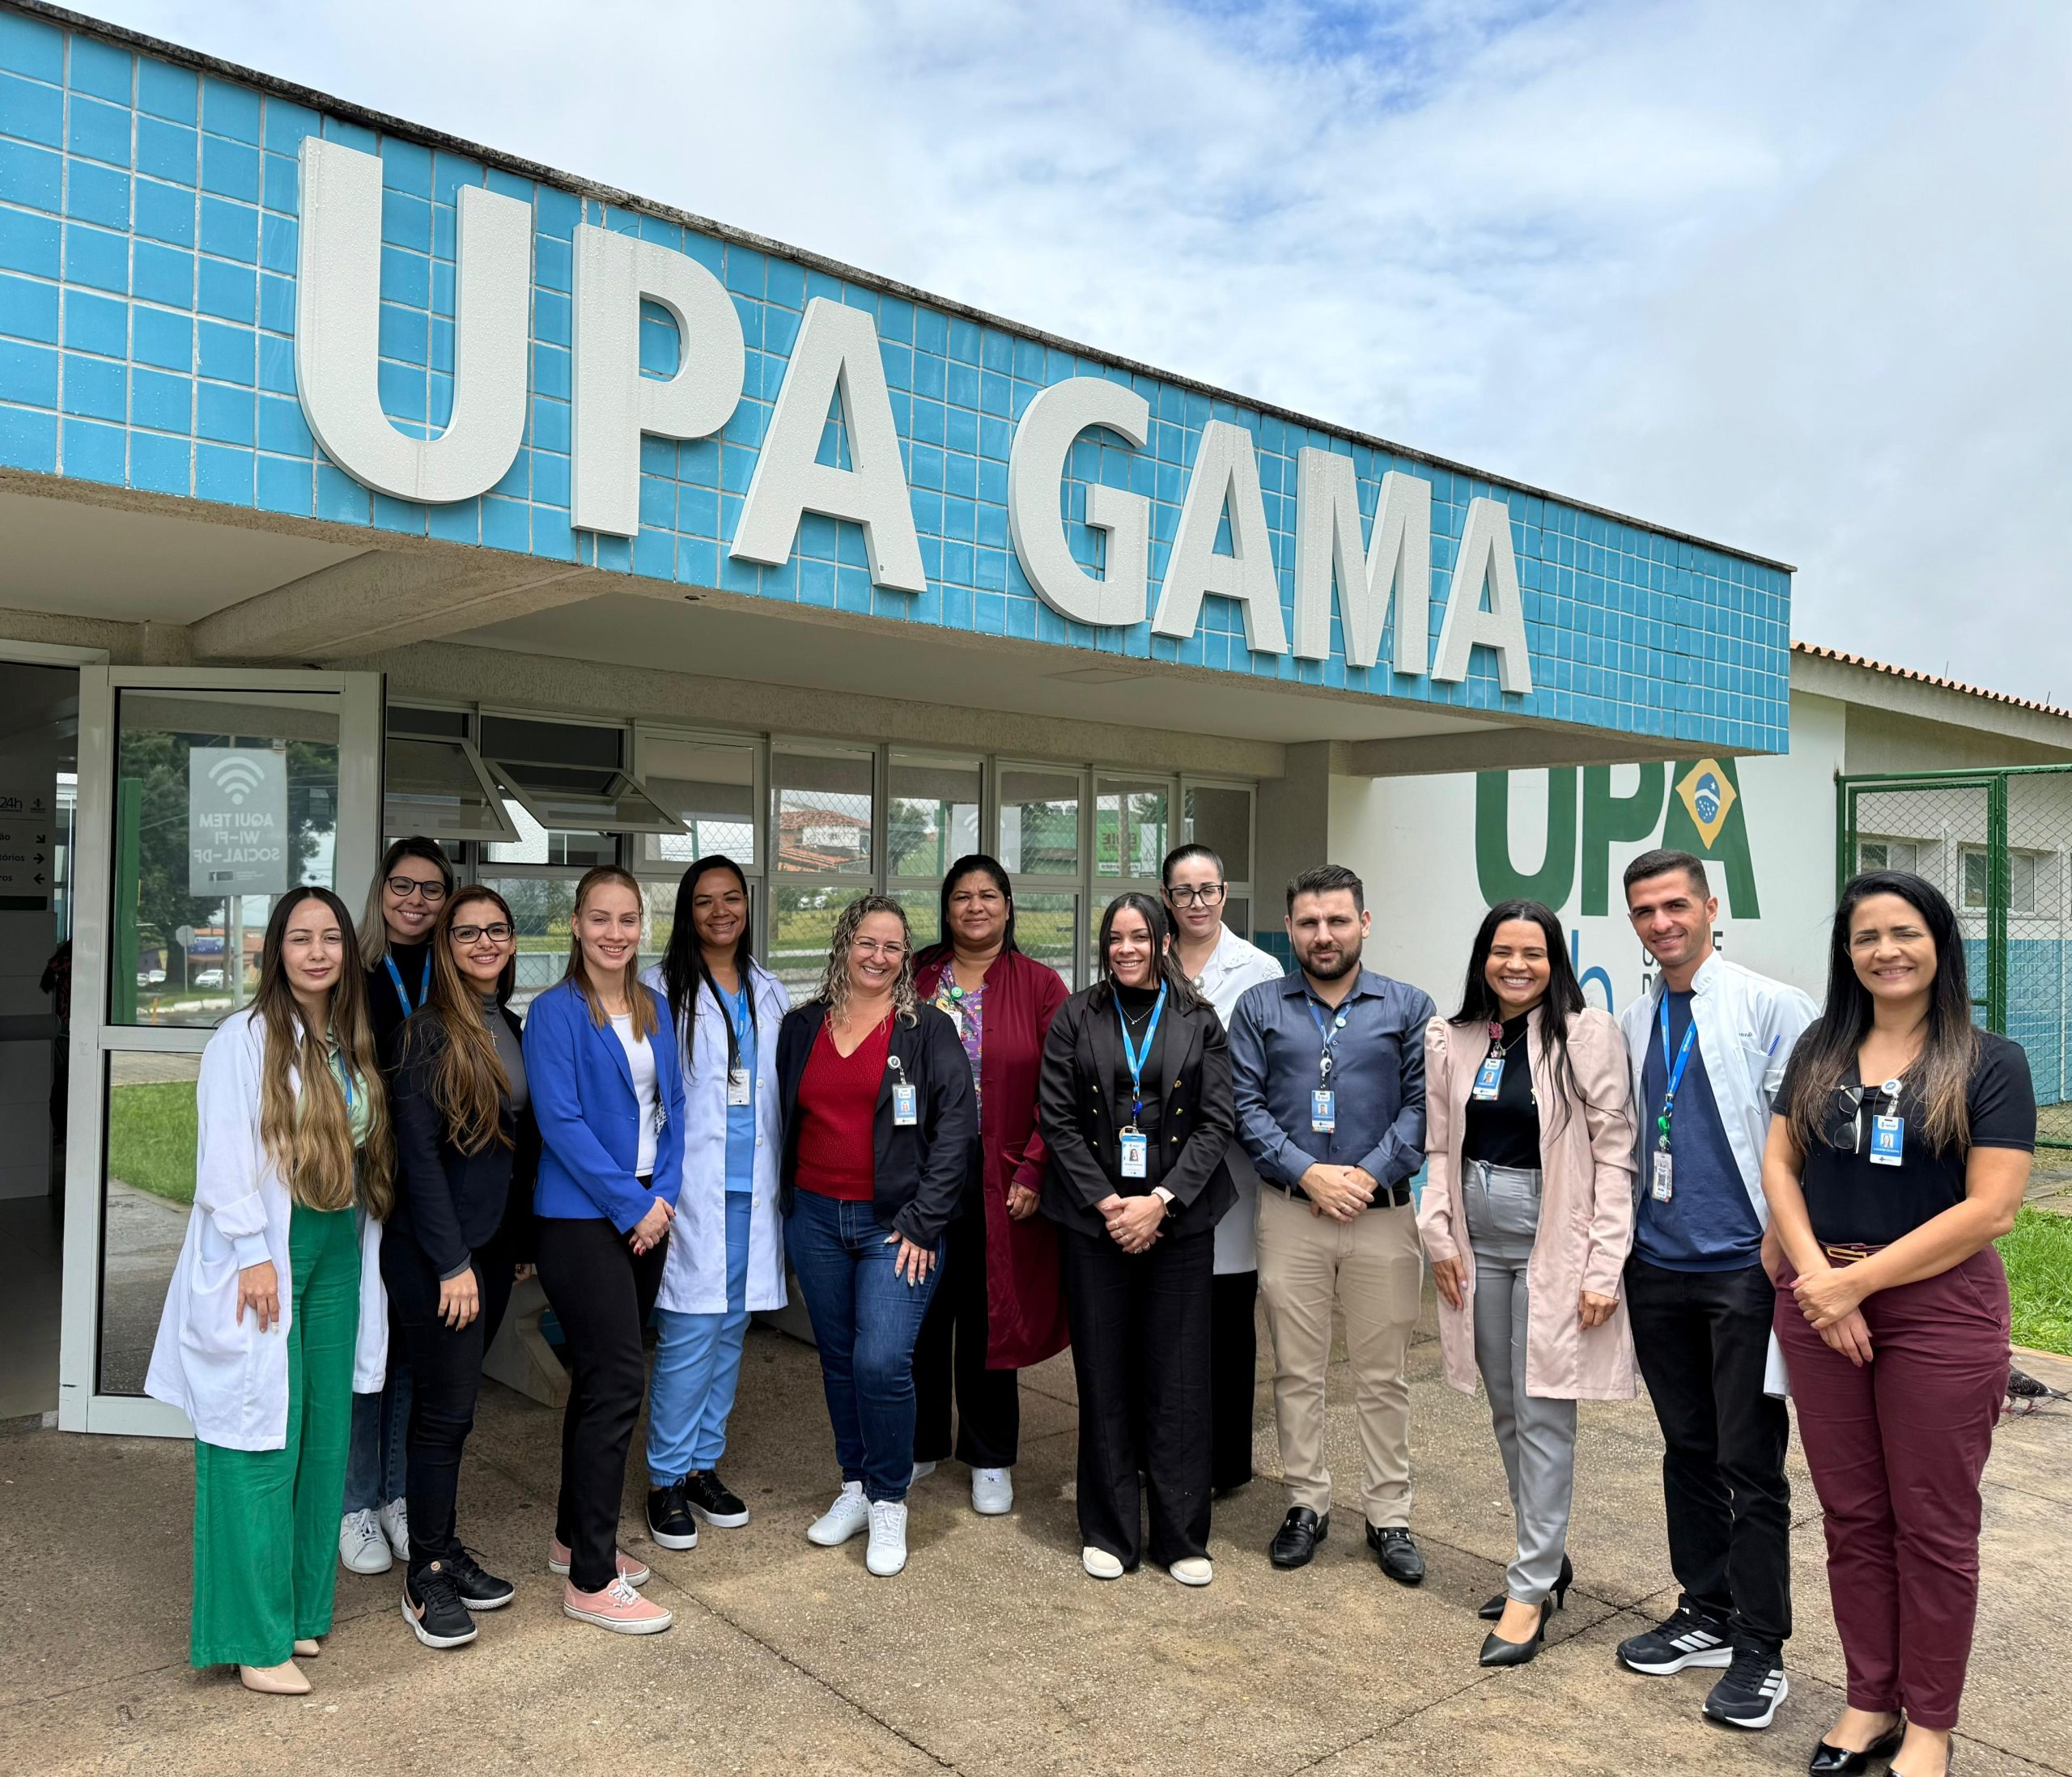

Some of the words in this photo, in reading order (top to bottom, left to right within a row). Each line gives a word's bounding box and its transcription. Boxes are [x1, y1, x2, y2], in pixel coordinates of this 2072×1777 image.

[295, 135, 928, 593] UPA
[1008, 376, 1532, 694] GAMA
[0, 797, 23, 808] 24h
[1475, 757, 1760, 919] UPA
